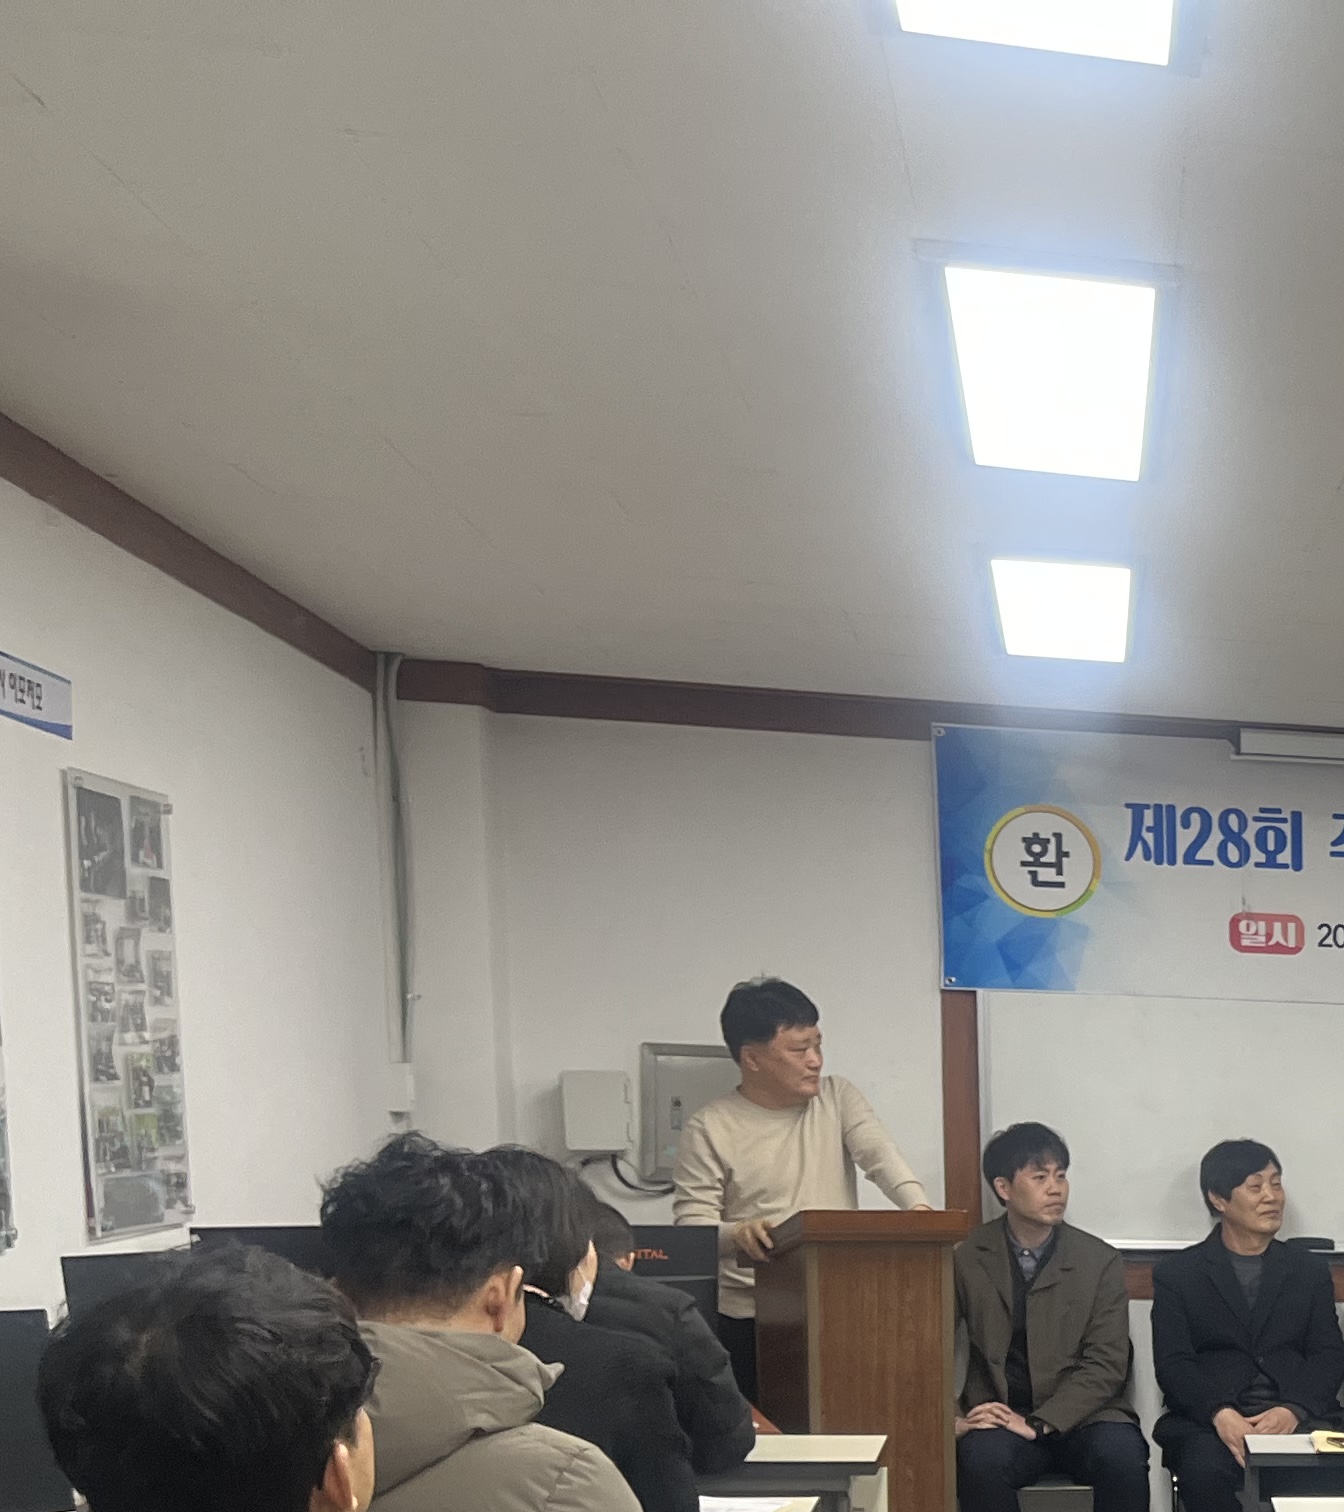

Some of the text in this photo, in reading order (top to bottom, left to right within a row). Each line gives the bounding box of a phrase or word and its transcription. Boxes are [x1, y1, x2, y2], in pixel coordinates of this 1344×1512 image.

[1019, 832, 1070, 889] 환
[1124, 802, 1303, 872] 제28회
[1238, 918, 1297, 949] 일시
